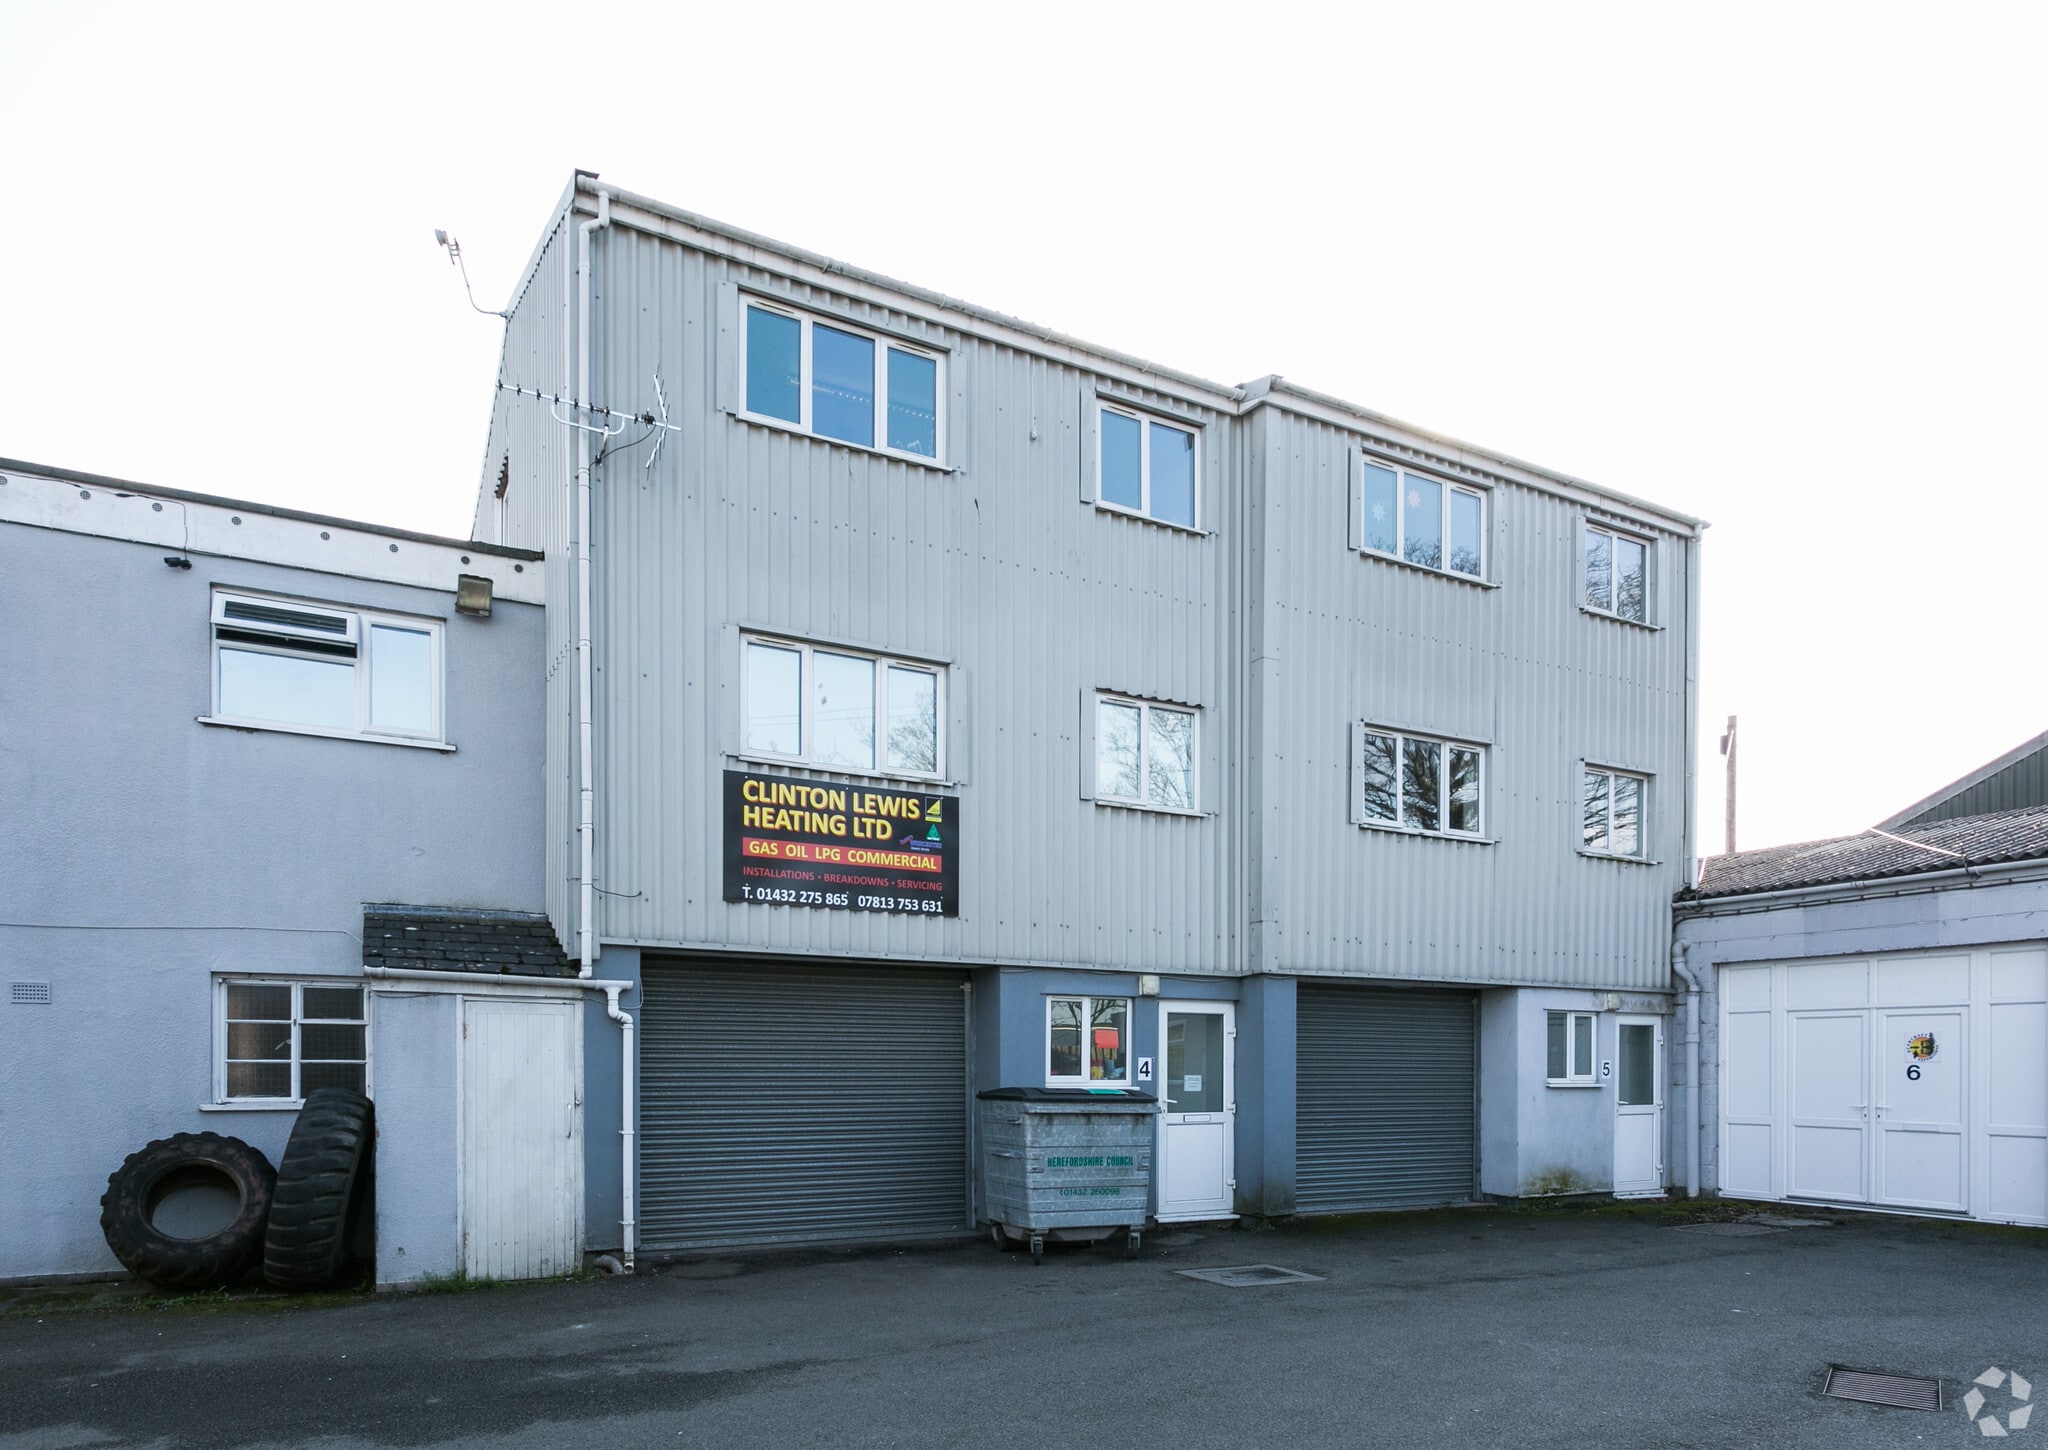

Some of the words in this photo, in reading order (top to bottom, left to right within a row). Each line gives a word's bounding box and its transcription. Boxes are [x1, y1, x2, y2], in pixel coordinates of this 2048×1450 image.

[742, 780, 847, 811] CLINTON
[853, 792, 921, 820] LEWIS
[743, 805, 847, 836] HEATING
[853, 816, 893, 840] LTD
[749, 841, 778, 856] GAS
[785, 844, 808, 858] OIL
[815, 847, 841, 861] LPG
[847, 850, 937, 869] COMMERCIAL
[743, 866, 815, 881] INSTALLATIONS
[824, 873, 889, 887] BREAKDOWNS
[897, 879, 943, 891] SERVICING
[756, 887, 796, 902] 01432
[799, 891, 822, 904] 275
[825, 893, 849, 906] 865
[858, 895, 895, 908] 07813
[897, 898, 919, 911] 753
[921, 900, 943, 913] 631
[1139, 1060, 1150, 1077] 4
[1602, 1062, 1610, 1076] 5
[1906, 1064, 1921, 1080] 6
[1047, 1156, 1104, 1167] HEREFORDSHIRE
[1106, 1155, 1134, 1166] COUNCIL
